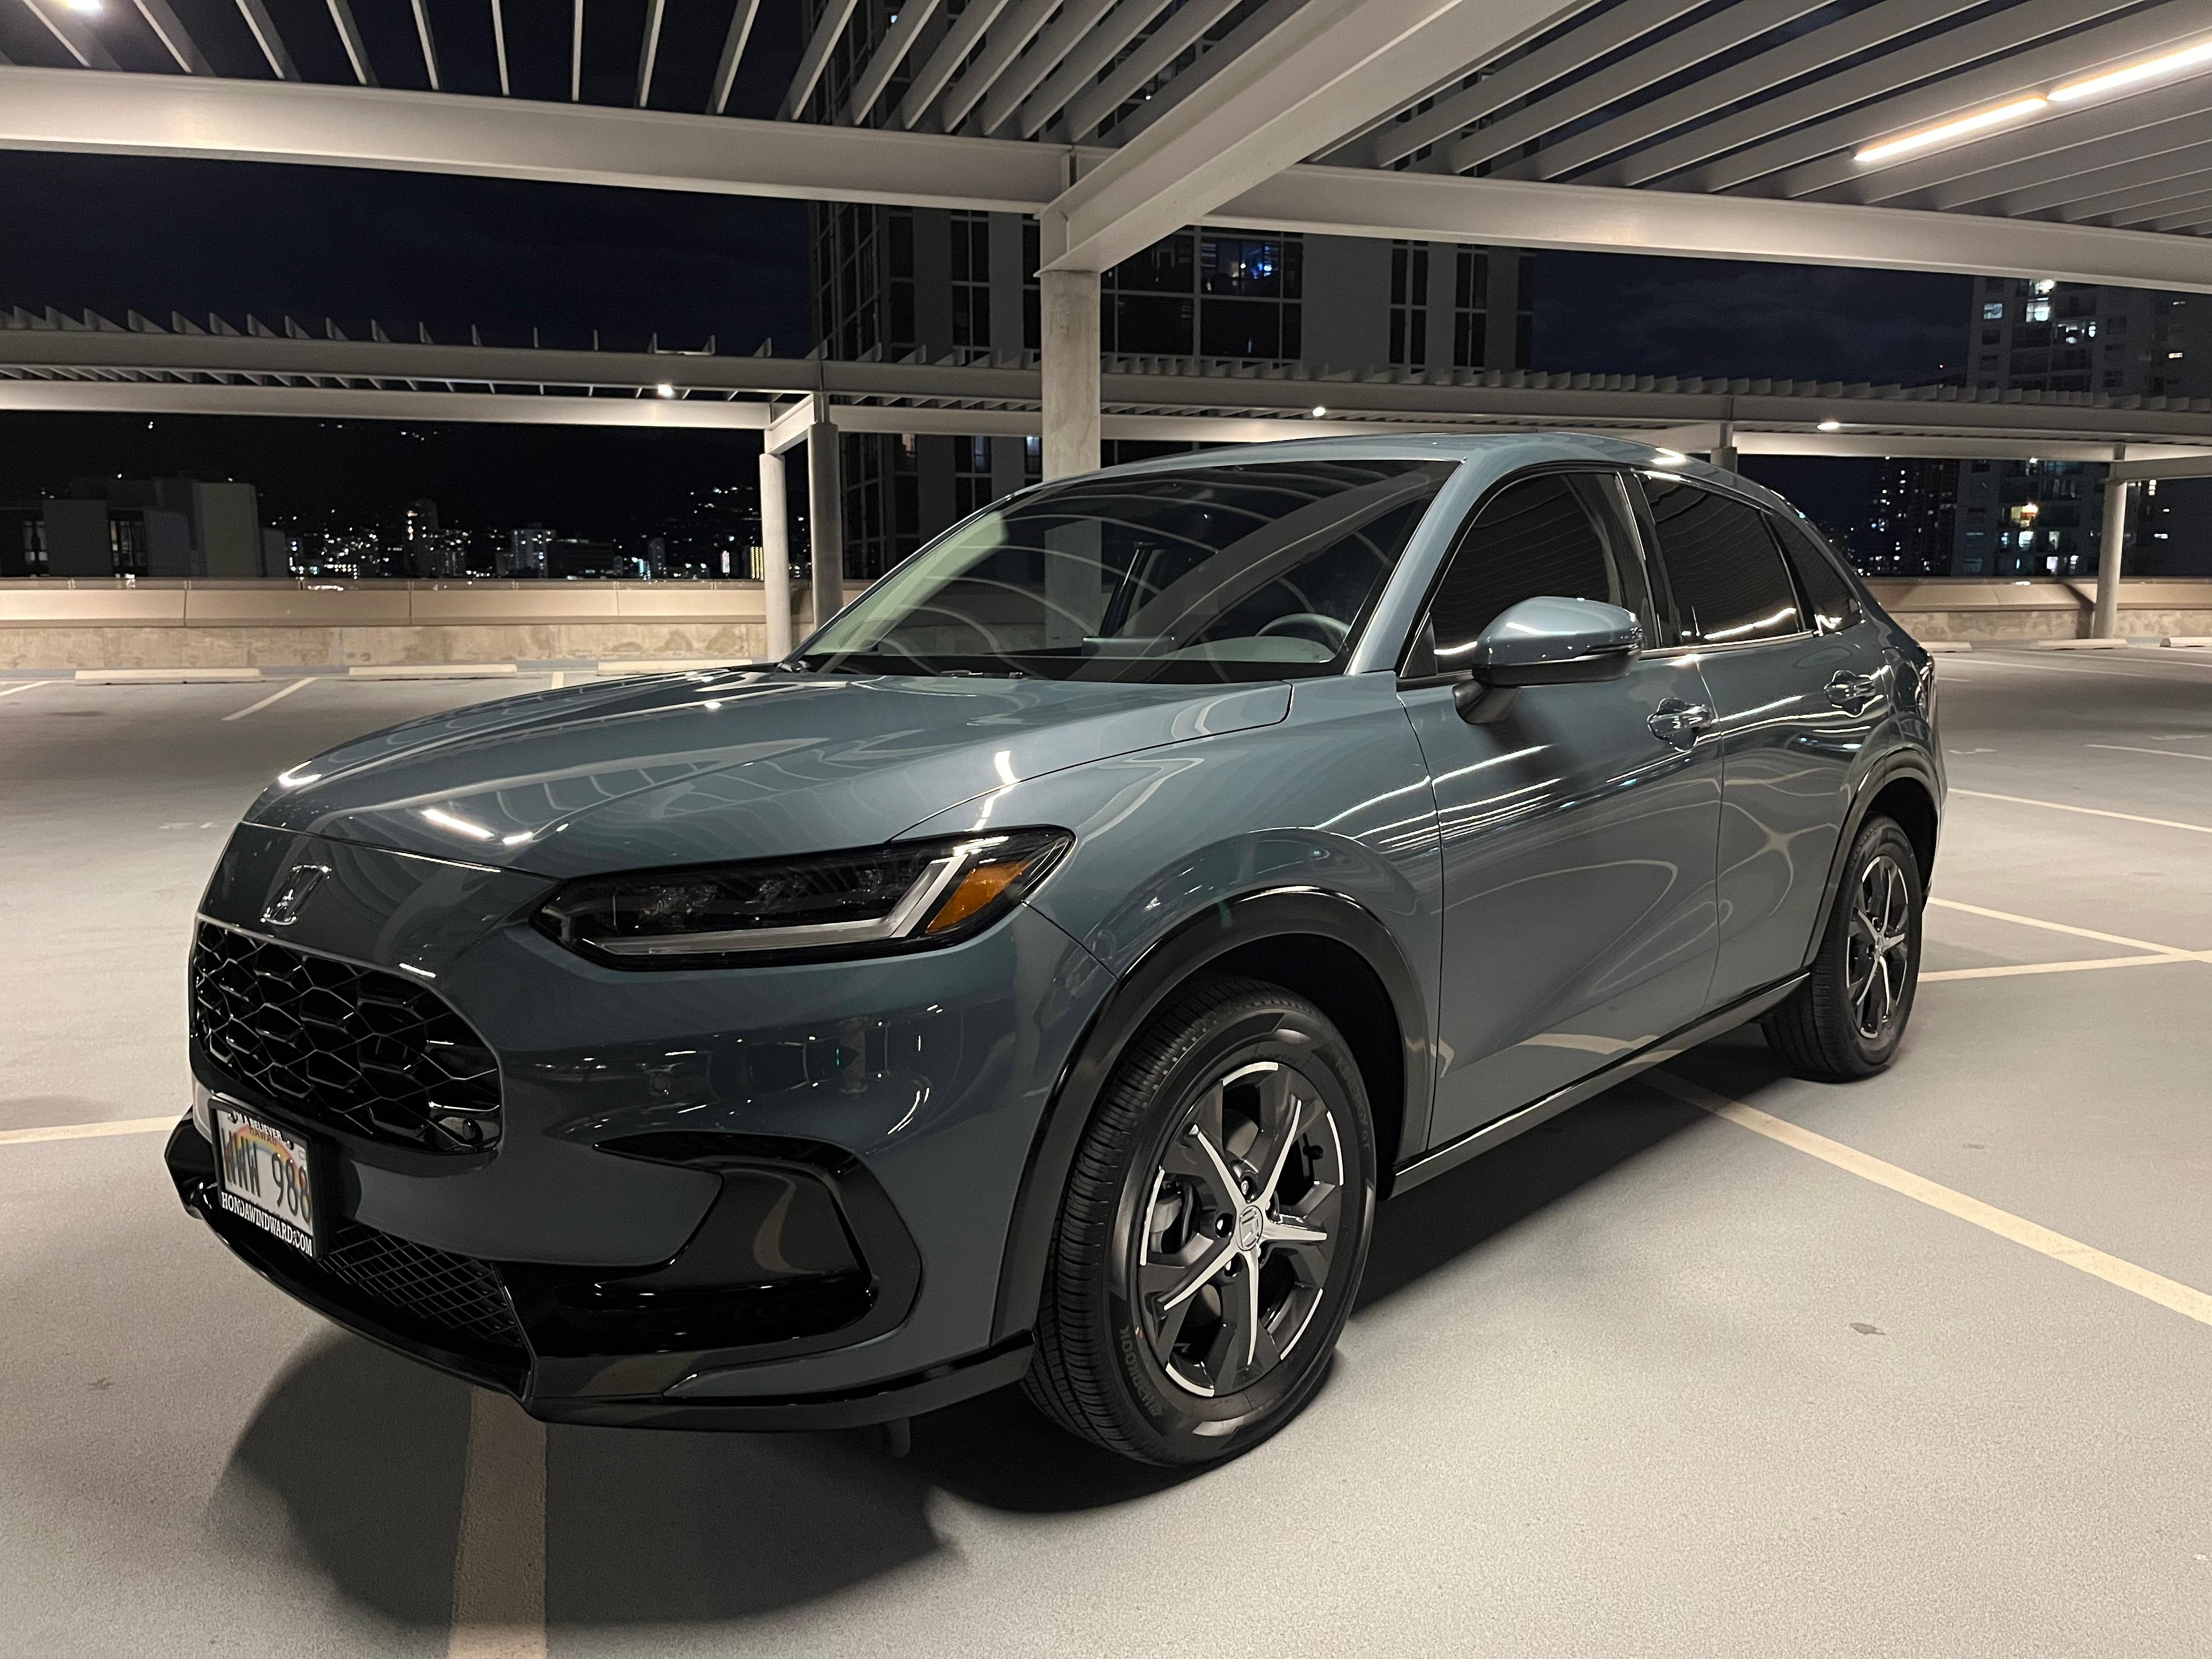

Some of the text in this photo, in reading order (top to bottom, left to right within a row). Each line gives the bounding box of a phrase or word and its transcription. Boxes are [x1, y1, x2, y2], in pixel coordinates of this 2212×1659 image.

[249, 1118, 283, 1141] BELIEVER
[272, 1153, 311, 1223] 988
[221, 1192, 313, 1257] HONDAWINDWARD.COM
